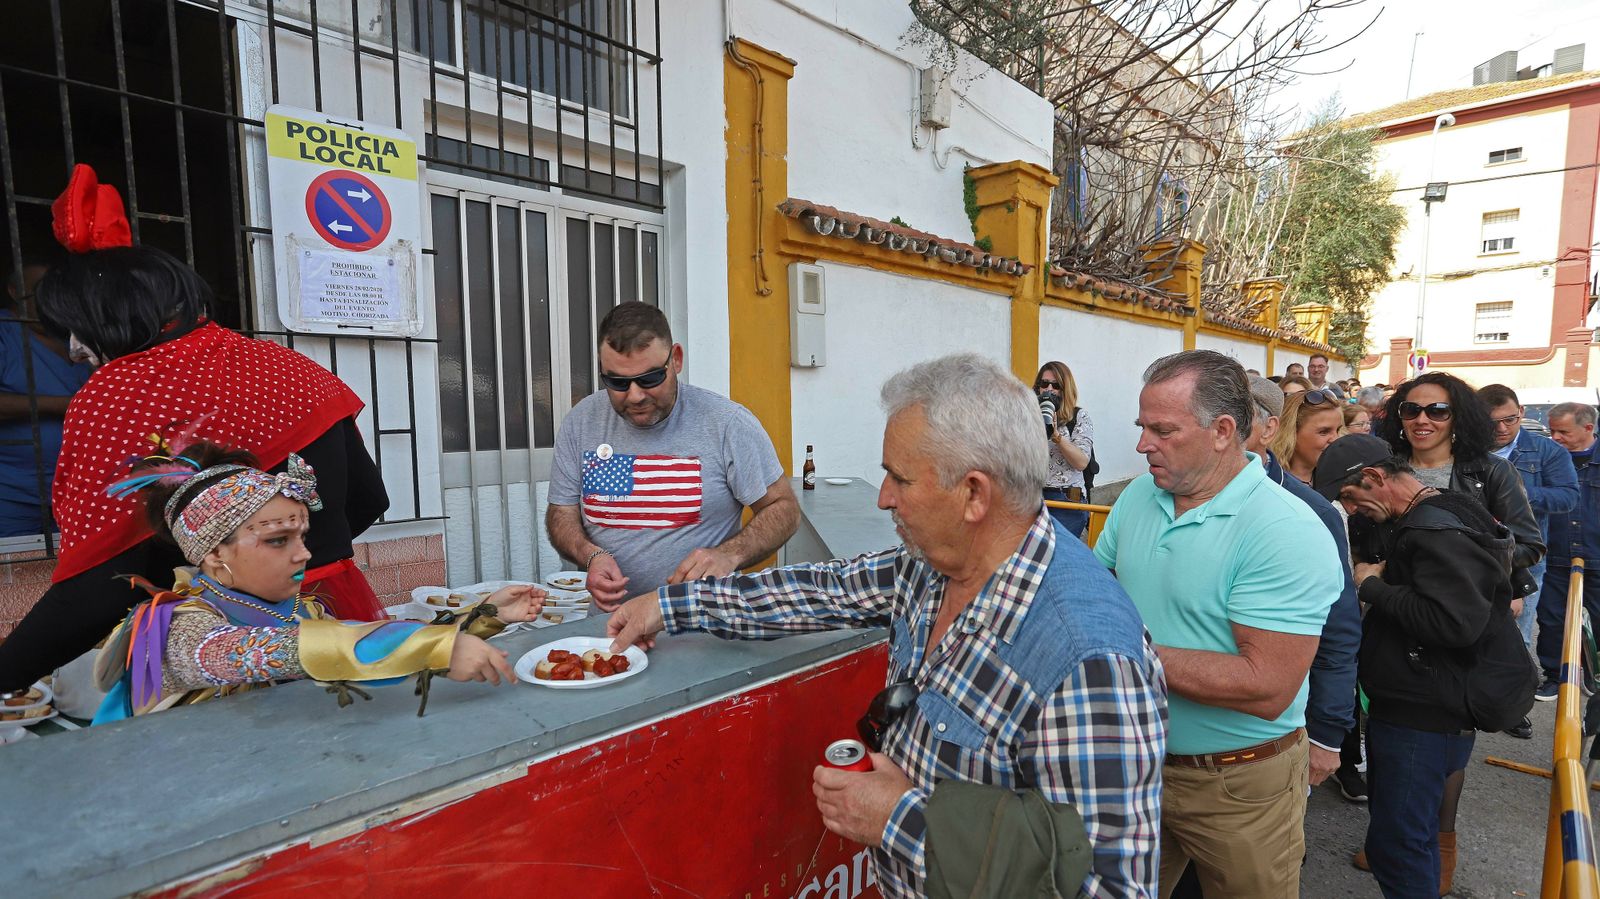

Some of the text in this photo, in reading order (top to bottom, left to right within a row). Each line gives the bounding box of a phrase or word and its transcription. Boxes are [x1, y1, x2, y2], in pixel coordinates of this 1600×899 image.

[286, 121, 399, 158] POLICIA
[299, 142, 391, 173] LOCAL
[331, 262, 373, 271] PROHIBIDO
